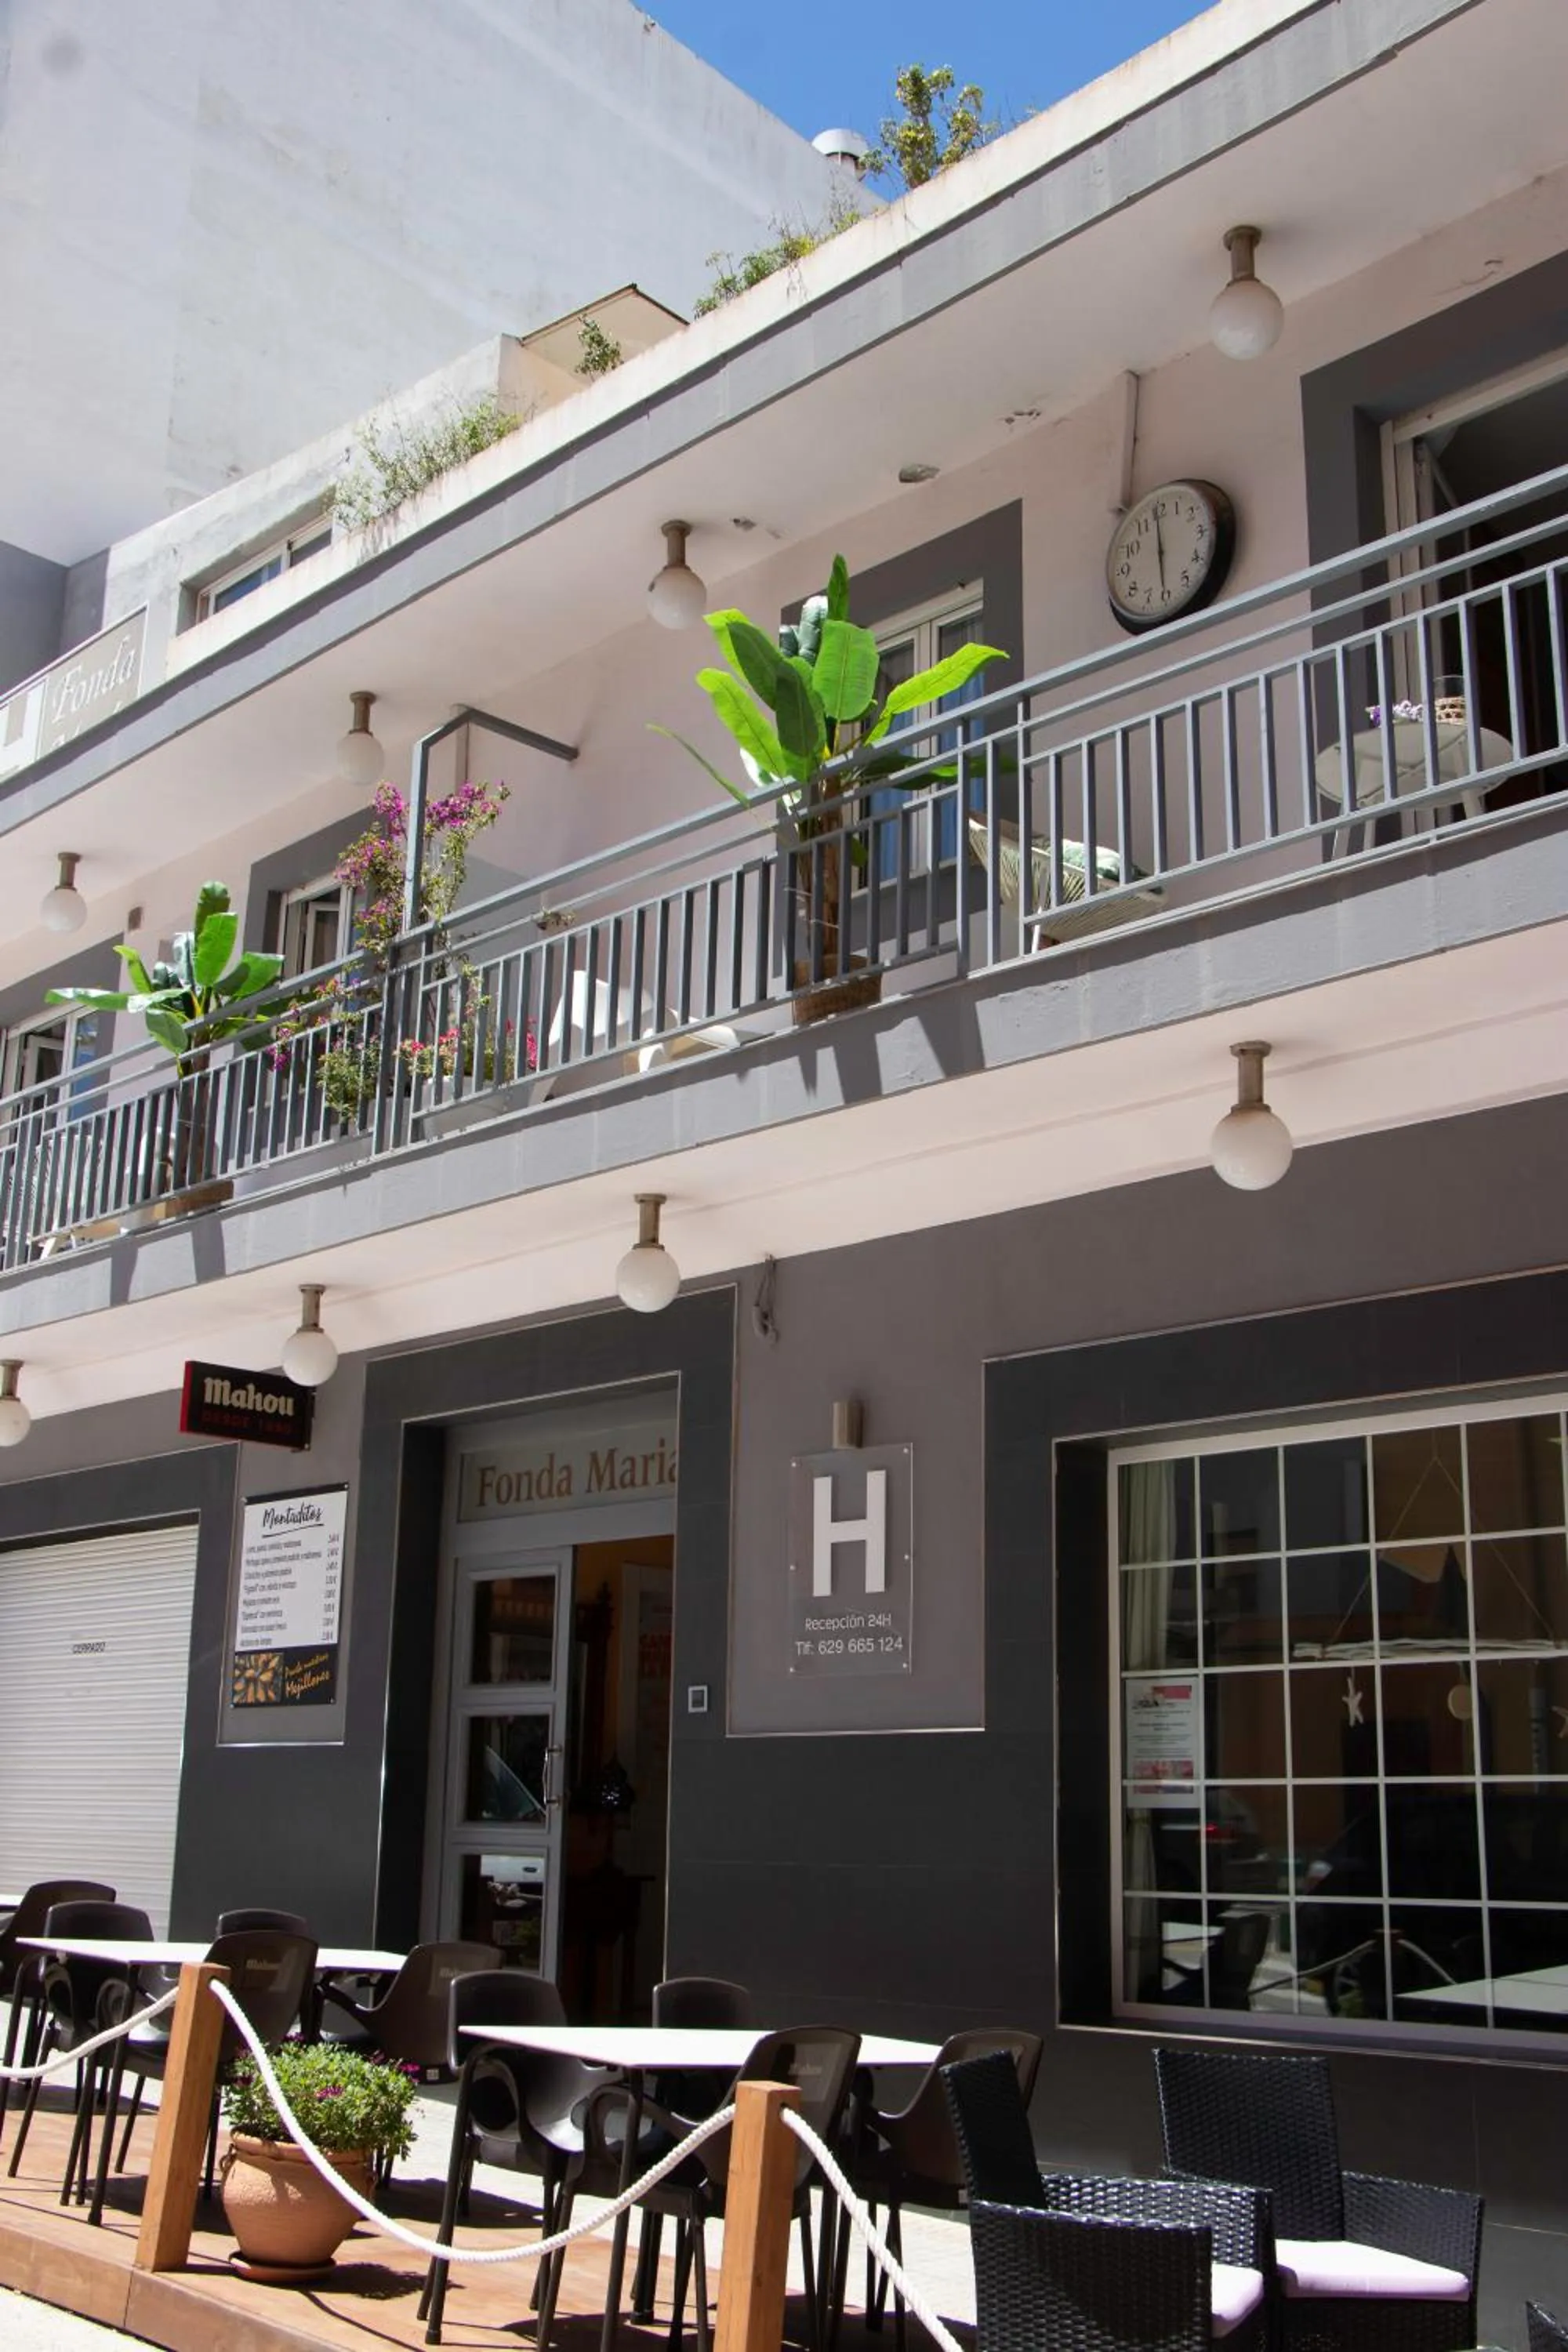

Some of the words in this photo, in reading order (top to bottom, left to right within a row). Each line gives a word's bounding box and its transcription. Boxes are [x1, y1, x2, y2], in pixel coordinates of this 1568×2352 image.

[52, 634, 135, 724] Fonda
[204, 1377, 294, 1417] Mahou
[476, 1453, 573, 1508] Fonda
[812, 1469, 887, 1597] H
[804, 1613, 865, 1632] Recepción
[868, 1612, 891, 1628] 24H
[818, 1639, 844, 1655] 629
[848, 1637, 874, 1653] 665
[878, 1635, 904, 1652] 124
